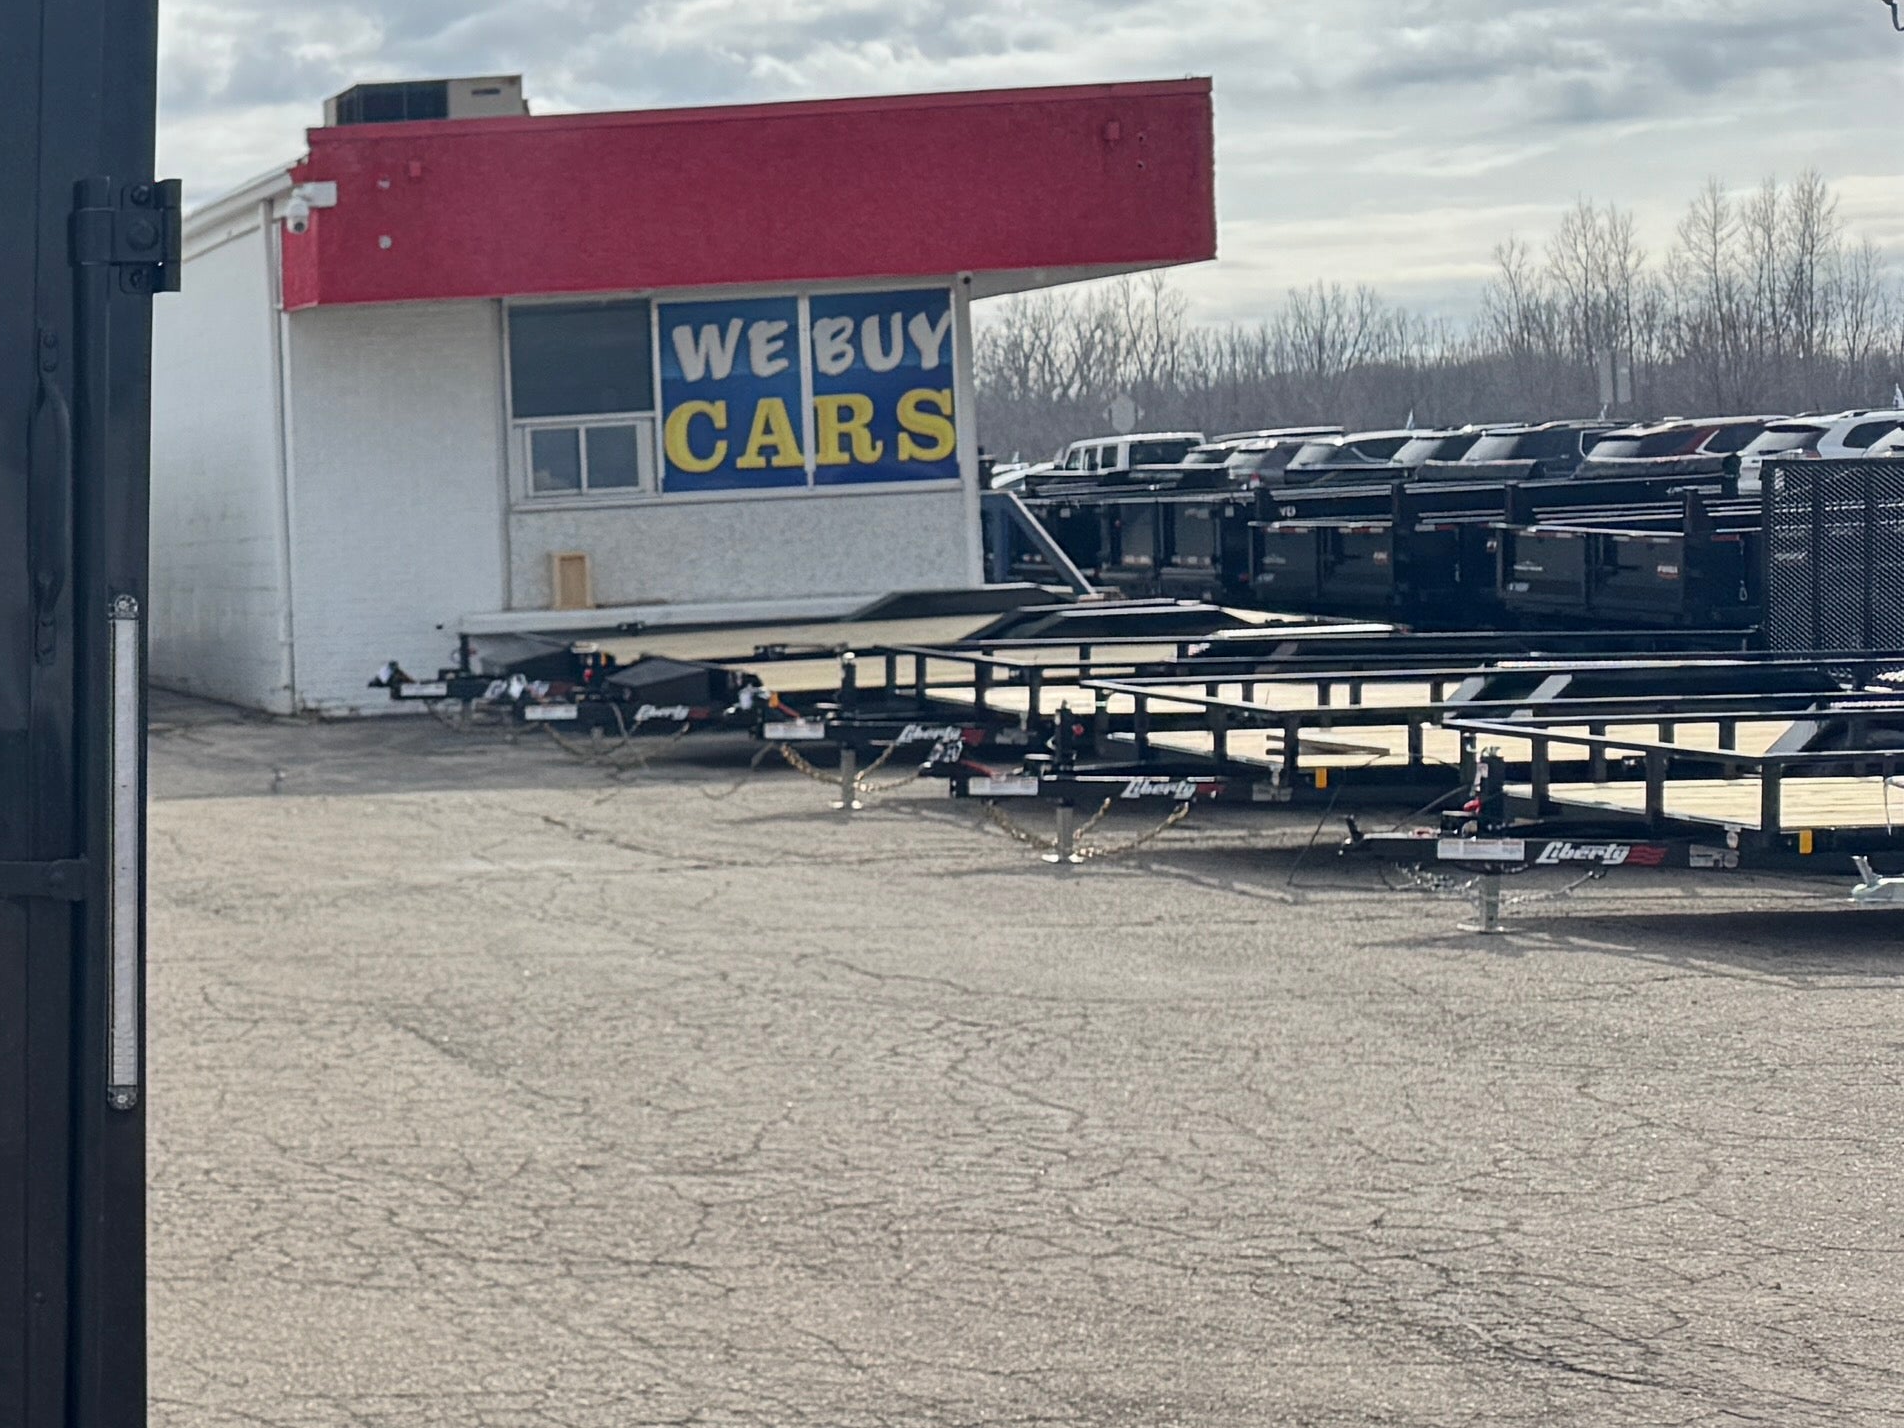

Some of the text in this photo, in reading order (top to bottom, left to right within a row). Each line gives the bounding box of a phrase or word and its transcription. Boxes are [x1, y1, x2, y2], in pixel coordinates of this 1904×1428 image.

[672, 310, 952, 383] WE BUY
[664, 388, 957, 473] CARS
[1120, 776, 1196, 800] Liberty
[1535, 841, 1632, 865] Liberty
